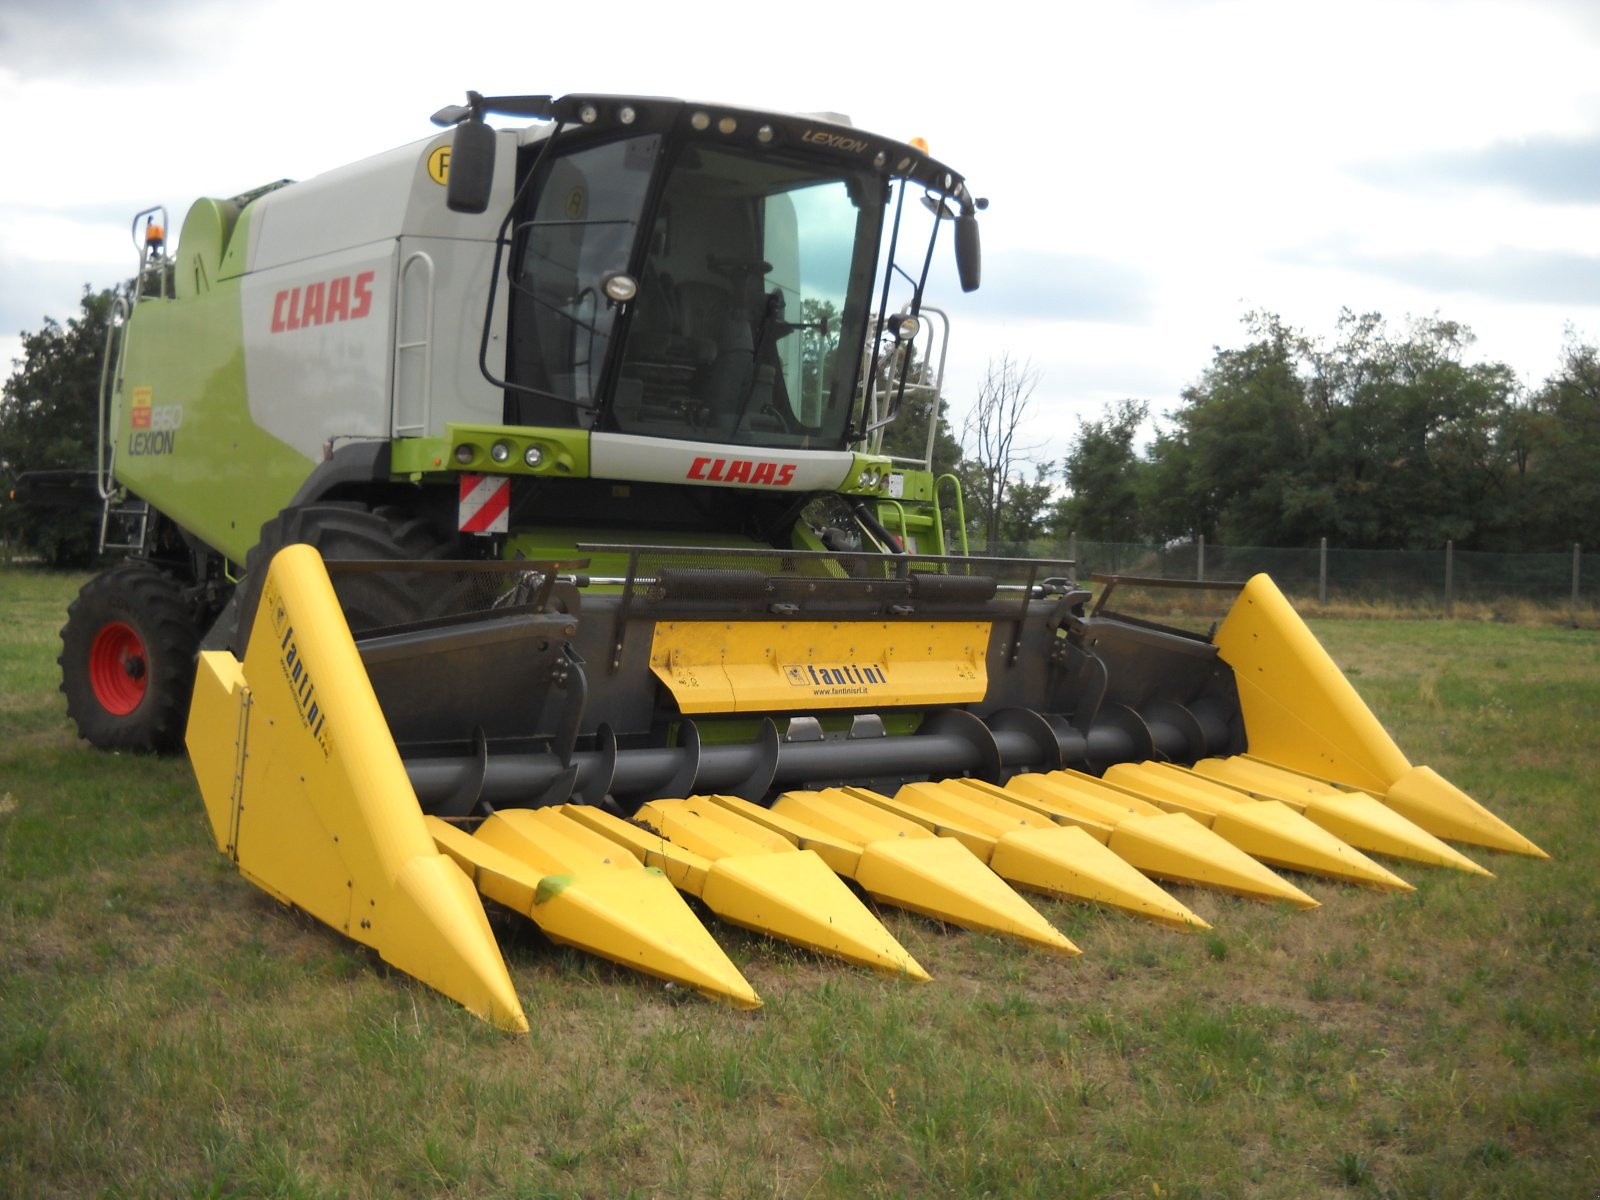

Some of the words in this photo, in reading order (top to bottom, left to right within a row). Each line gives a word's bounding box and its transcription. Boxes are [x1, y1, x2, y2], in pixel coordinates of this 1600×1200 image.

[802, 129, 868, 153] LEXION
[270, 271, 375, 334] CLAAS
[128, 431, 175, 456] LEXION
[686, 457, 797, 486] CLAAS
[281, 626, 326, 739] fantini
[807, 663, 887, 685] fantini
[813, 687, 868, 696] www.fantinisrl.it
